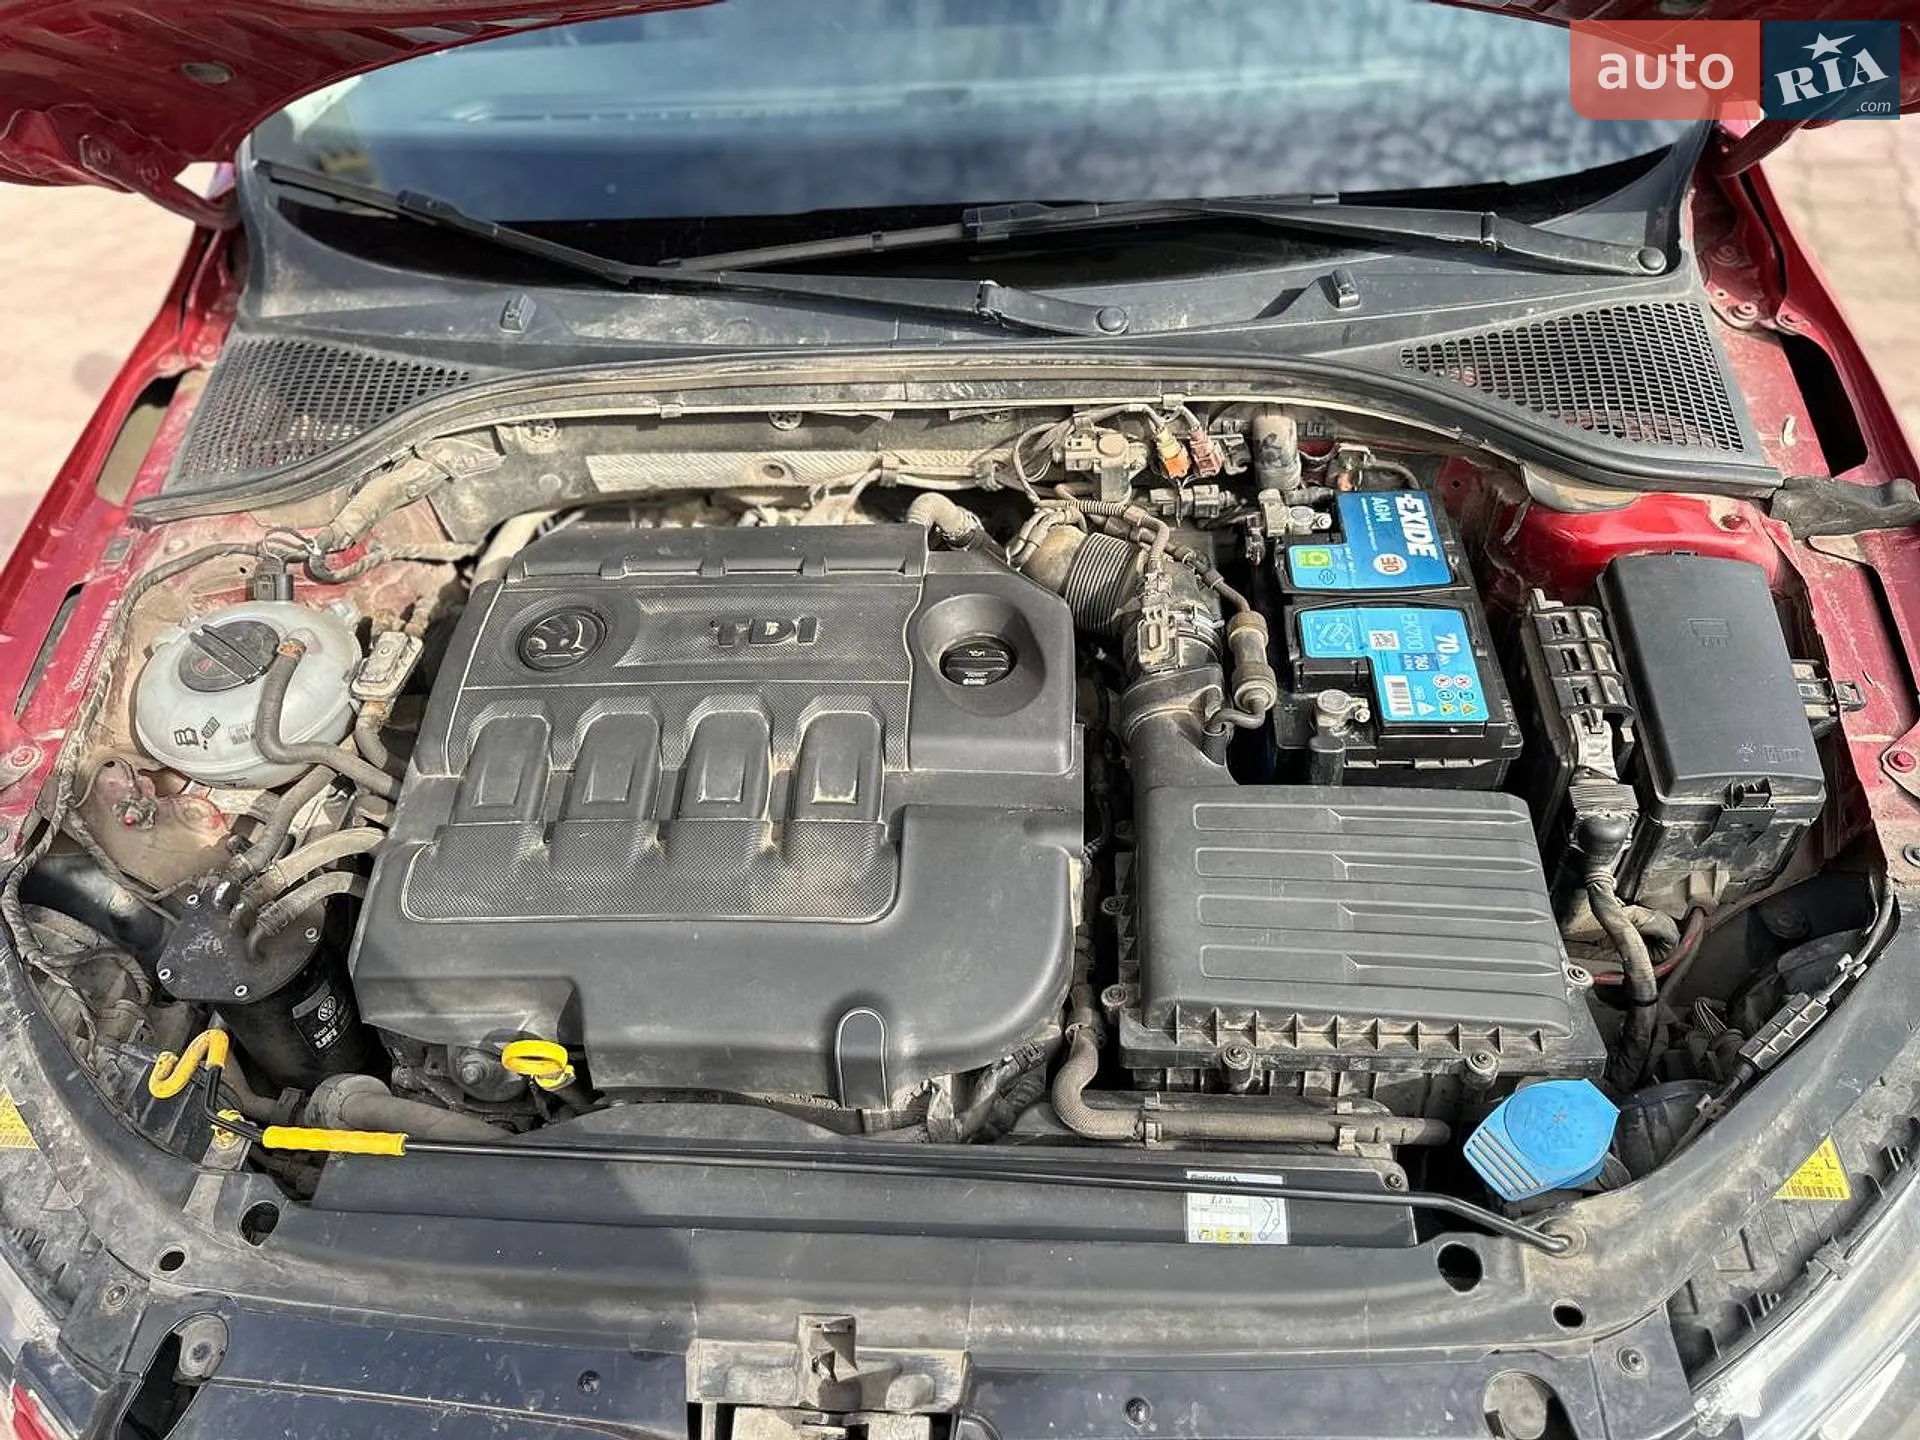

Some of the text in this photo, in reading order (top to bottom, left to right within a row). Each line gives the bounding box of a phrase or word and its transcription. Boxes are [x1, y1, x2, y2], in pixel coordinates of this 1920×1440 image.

[1371, 496, 1393, 522] AGM
[1395, 494, 1438, 560] EXIDE
[711, 616, 819, 647] TDI
[1400, 613, 1425, 651] EK700
[1434, 633, 1460, 654] 70
